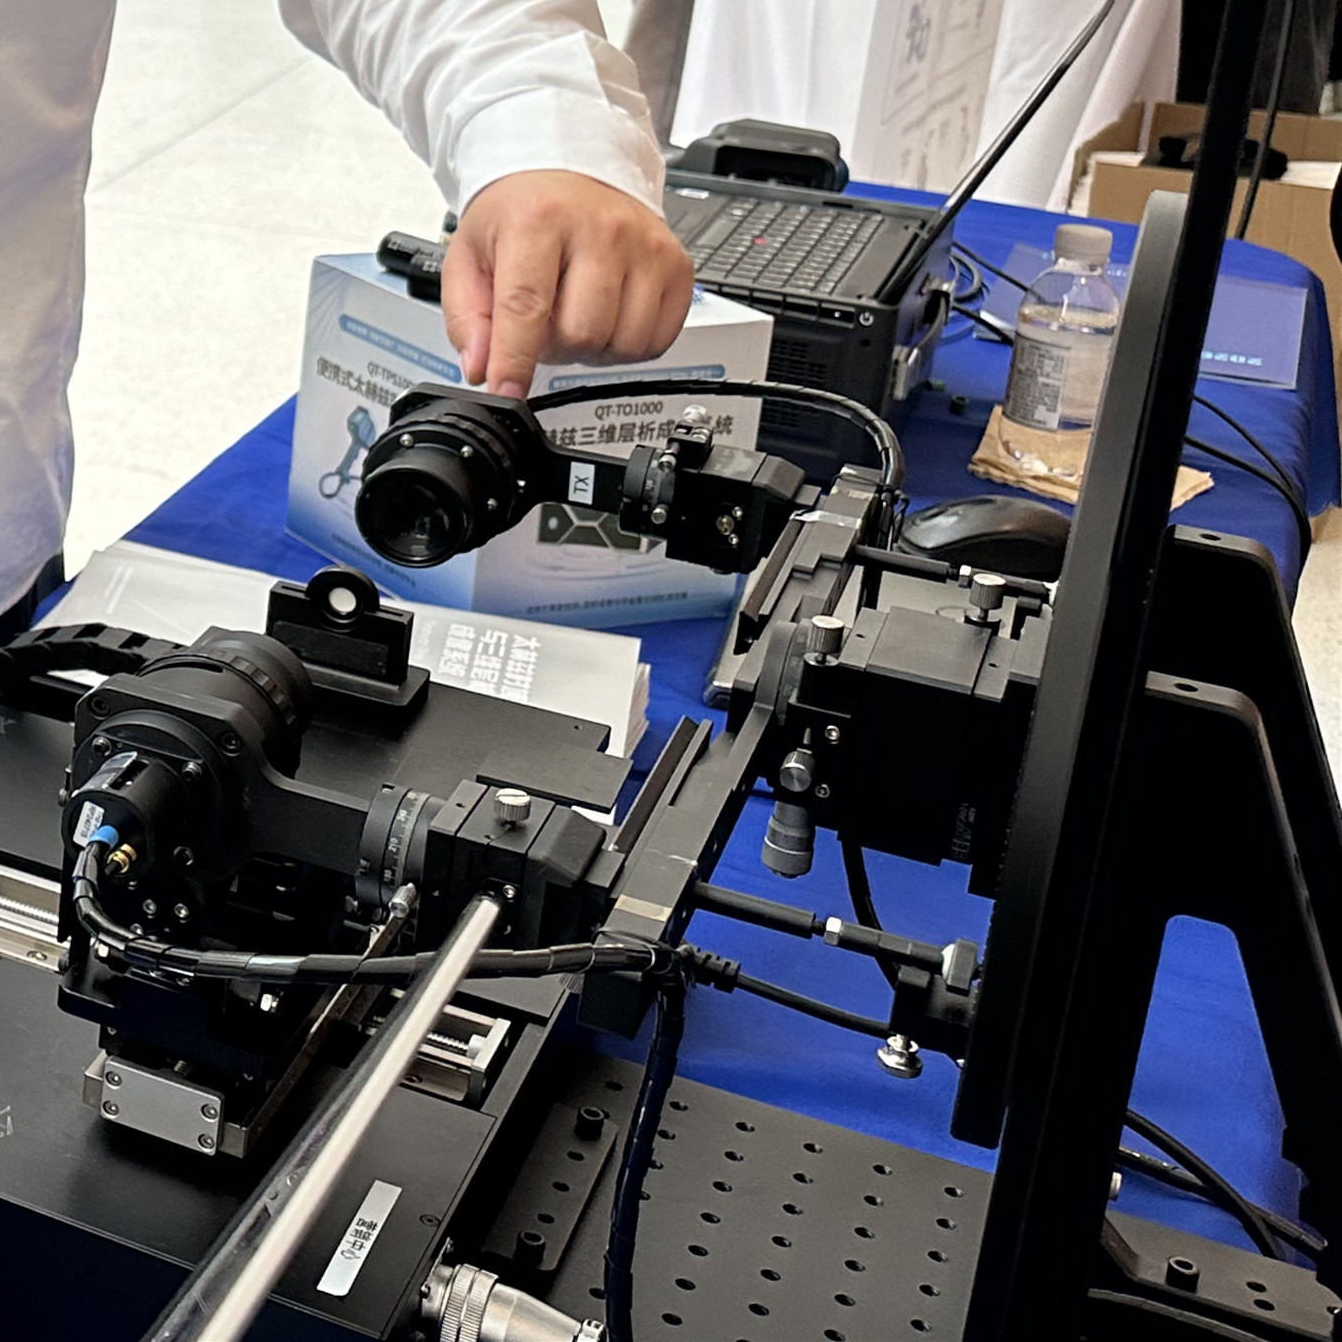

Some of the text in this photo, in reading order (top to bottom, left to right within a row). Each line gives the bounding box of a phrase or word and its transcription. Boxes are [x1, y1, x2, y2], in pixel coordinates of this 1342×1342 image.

[595, 401, 664, 420] QT-TO1000
[574, 474, 590, 494] TX
[339, 1218, 379, 1261] 营销中心
